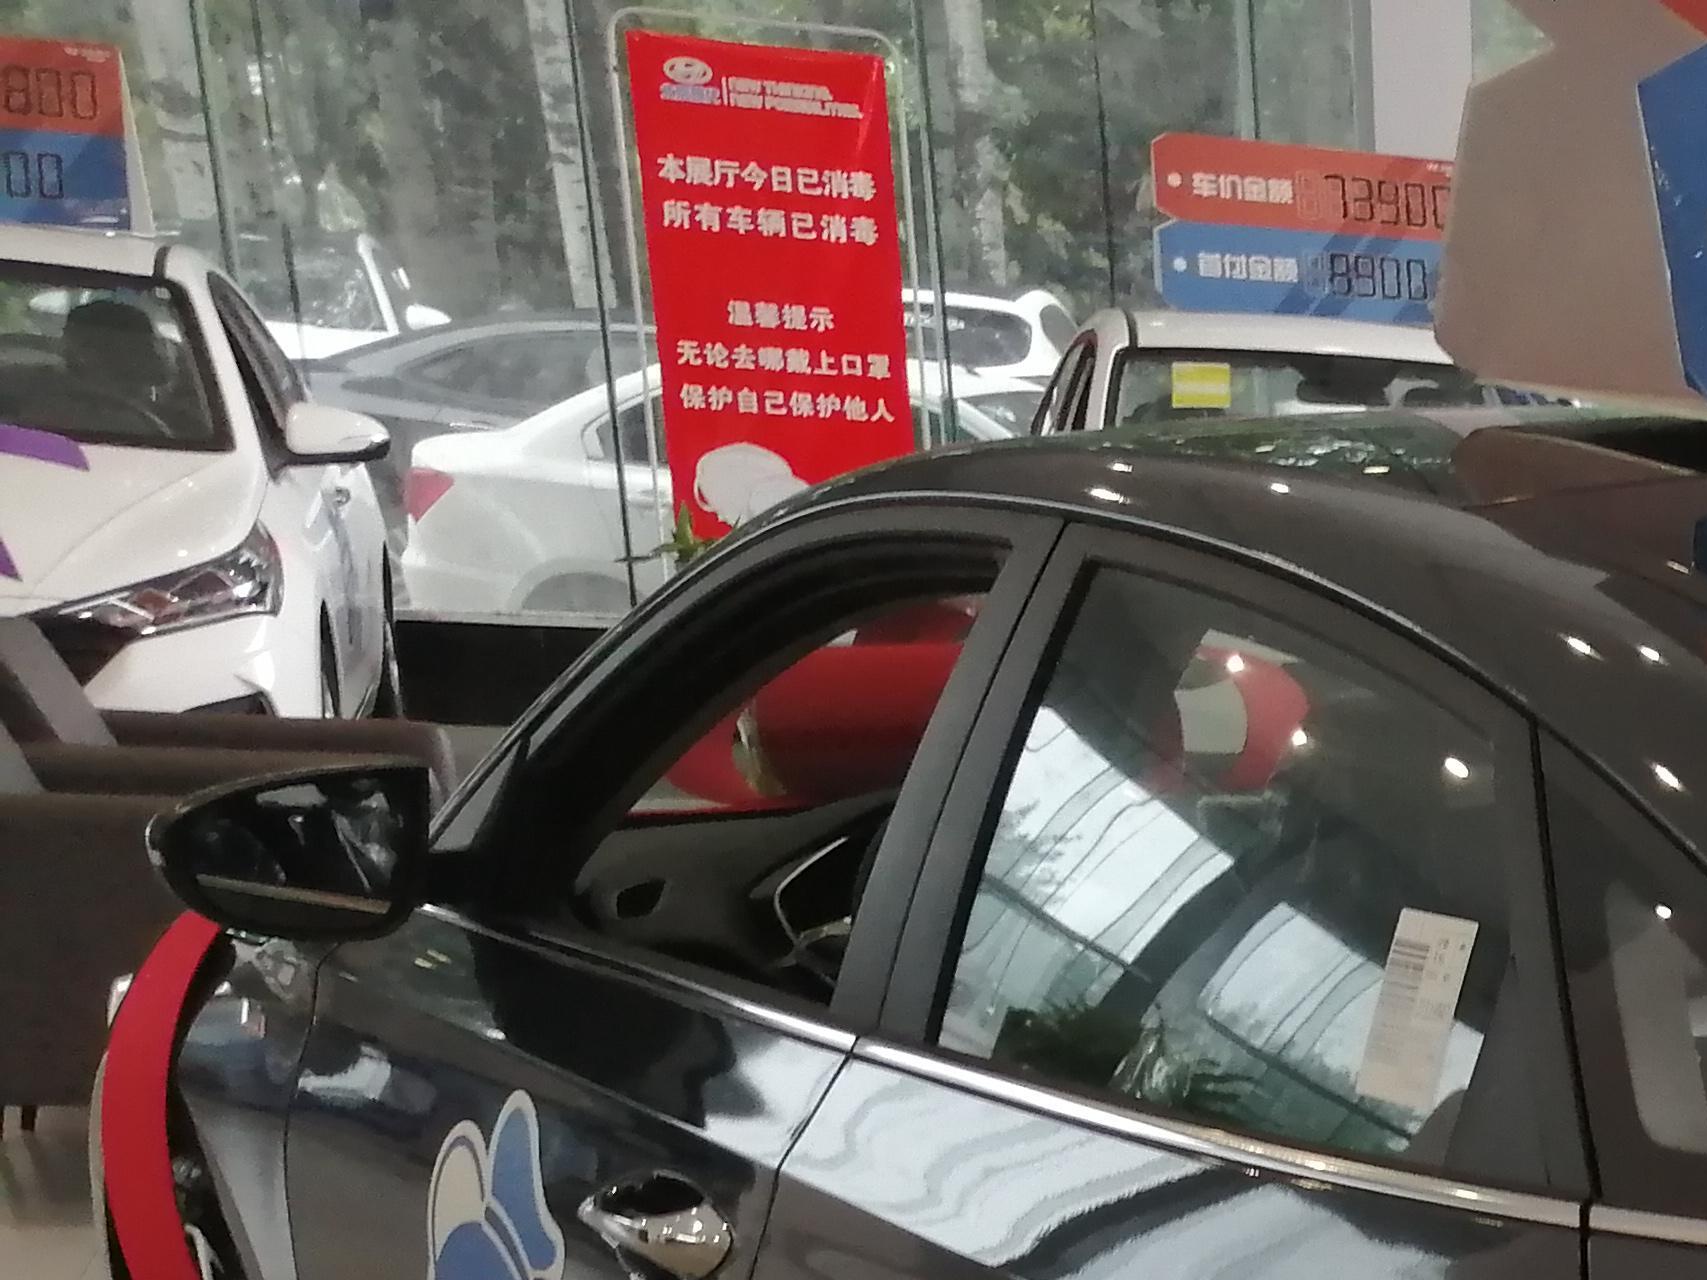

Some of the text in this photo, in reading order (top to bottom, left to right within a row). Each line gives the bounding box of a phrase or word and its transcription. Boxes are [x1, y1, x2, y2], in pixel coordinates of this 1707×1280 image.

[657, 153, 876, 202] 本展厅今日已消毒
[662, 199, 879, 246] 所有车辆已消毒
[676, 339, 890, 379] 无论去哪戴上口罩
[680, 383, 895, 423] 保护自己保护他人
